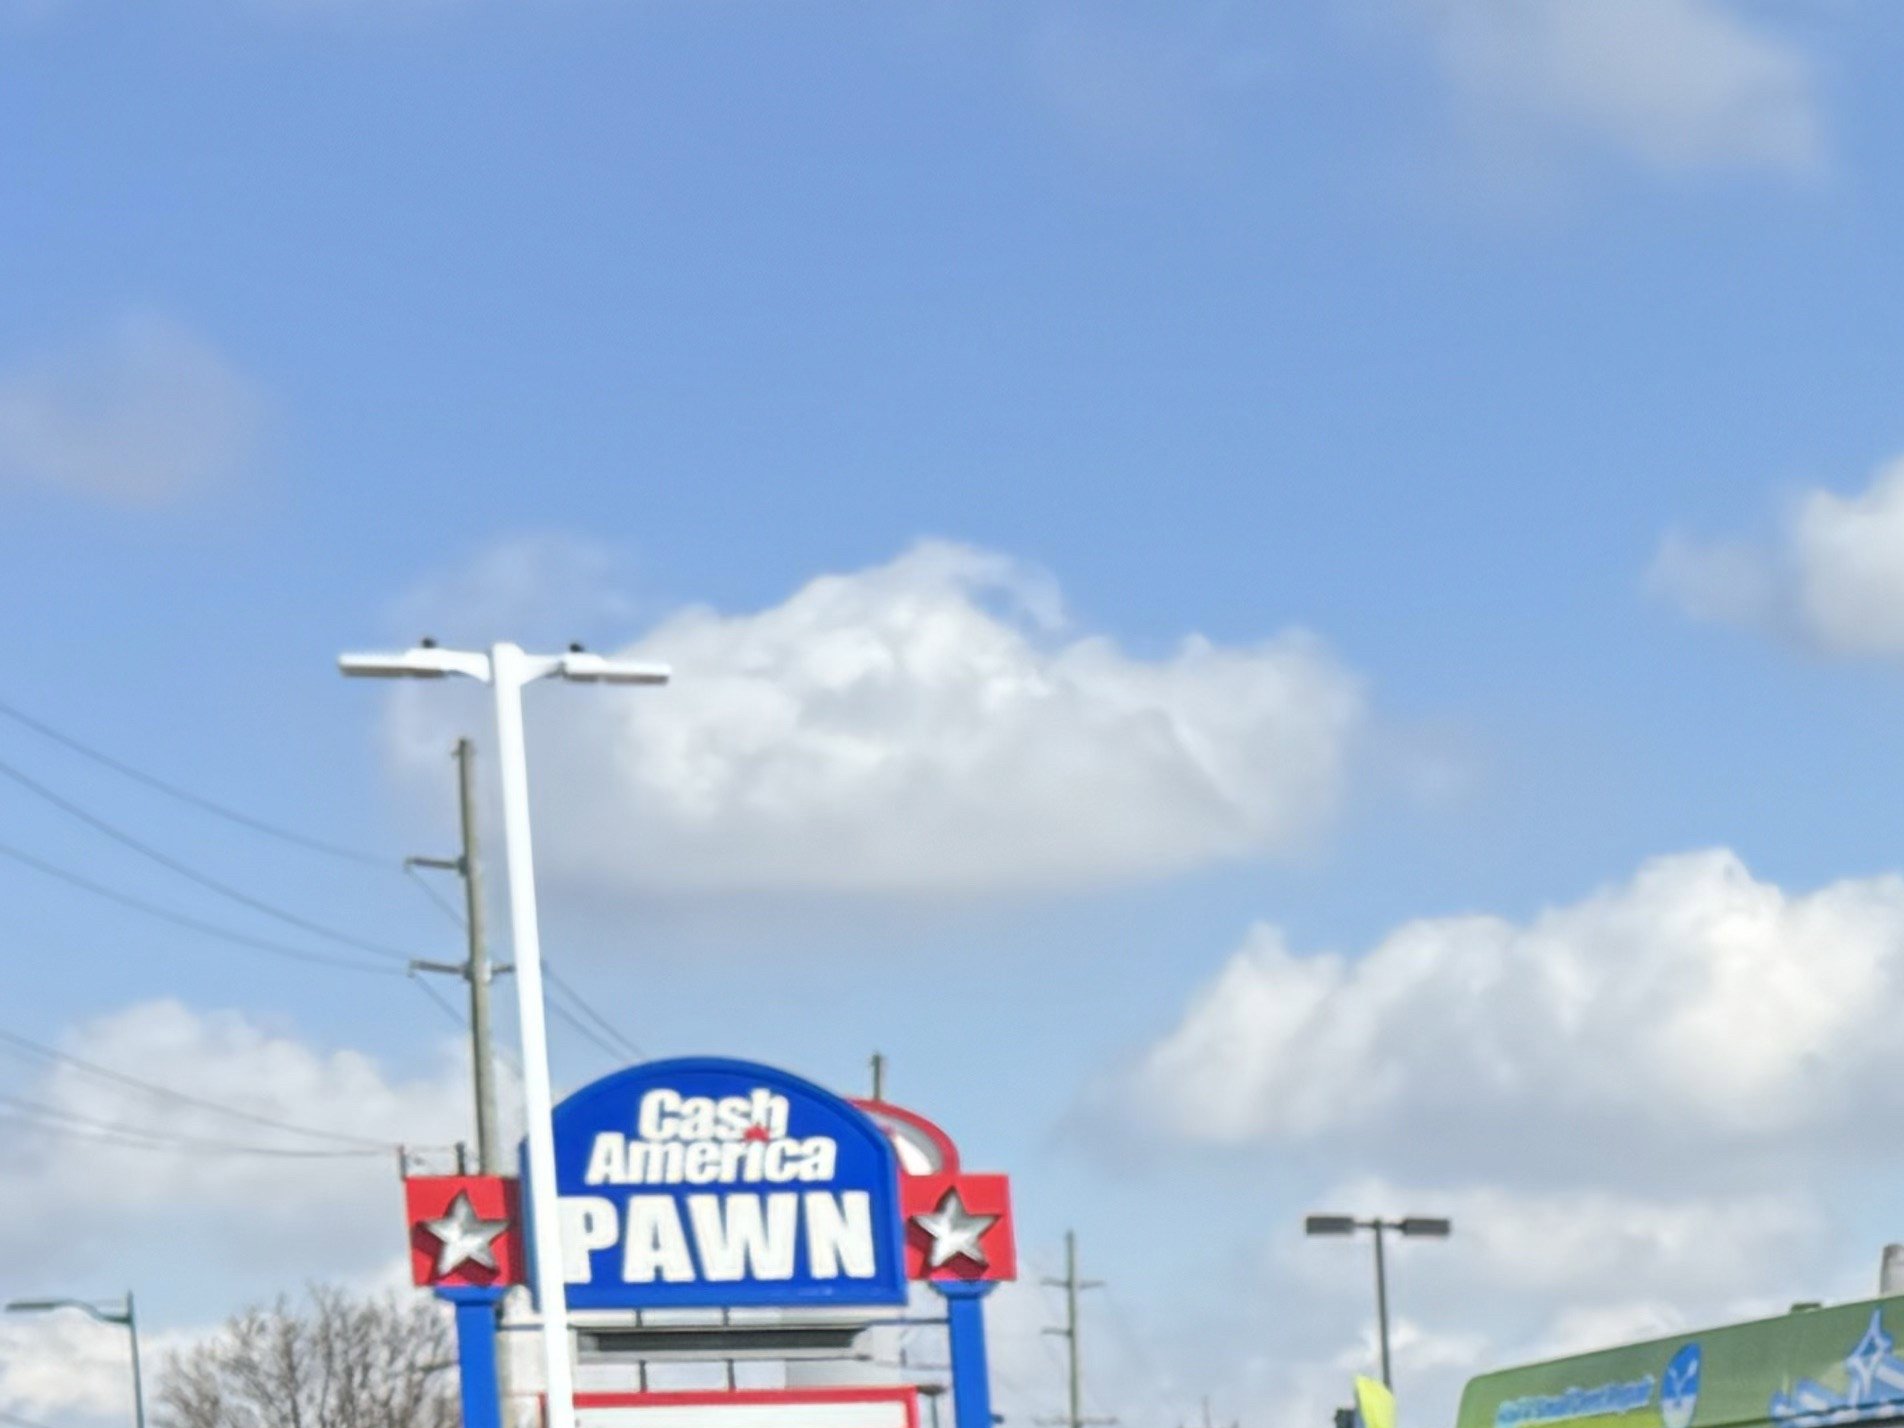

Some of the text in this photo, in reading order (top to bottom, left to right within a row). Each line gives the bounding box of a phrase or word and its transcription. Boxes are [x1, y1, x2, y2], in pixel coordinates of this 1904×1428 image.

[639, 1088, 789, 1141] Cash
[585, 1132, 837, 1185] America
[556, 1190, 876, 1284] PAWN
